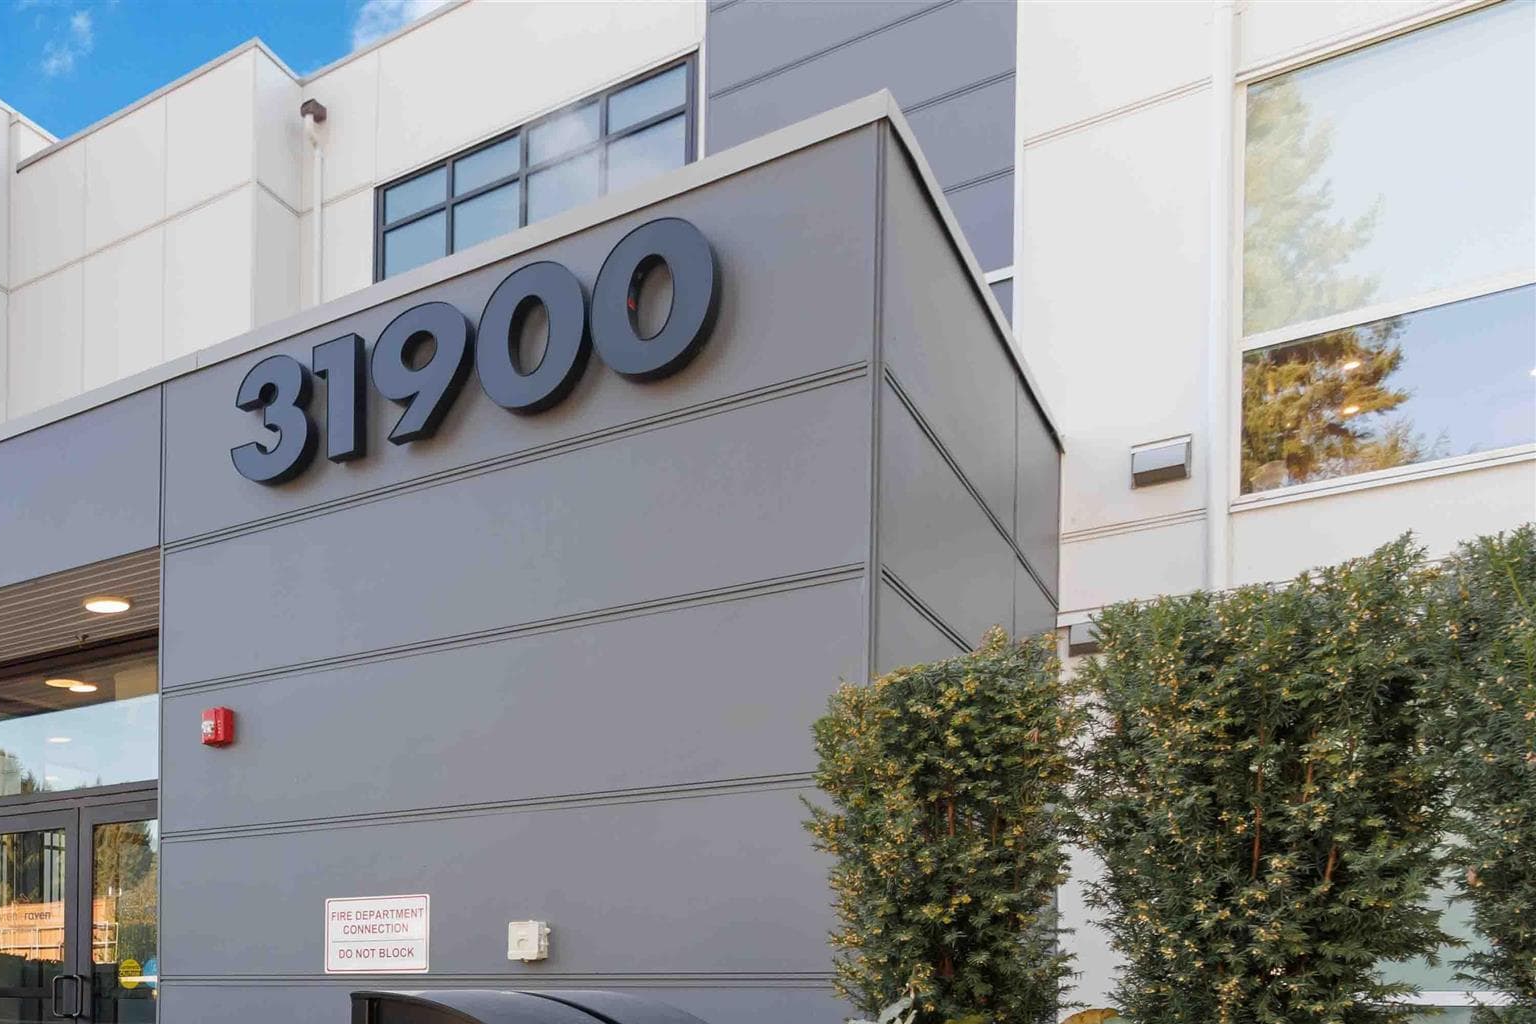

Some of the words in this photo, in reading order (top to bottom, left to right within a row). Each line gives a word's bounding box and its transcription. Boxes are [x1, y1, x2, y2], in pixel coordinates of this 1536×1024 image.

[230, 217, 721, 486] 31900
[24, 911, 51, 920] raven
[331, 911, 352, 921] FIRE
[355, 908, 424, 920] DEPARTMENT
[343, 923, 409, 935] CONNECTION
[339, 949, 352, 959] DO
[356, 948, 376, 959] NOT
[379, 947, 414, 958] BLOCK
